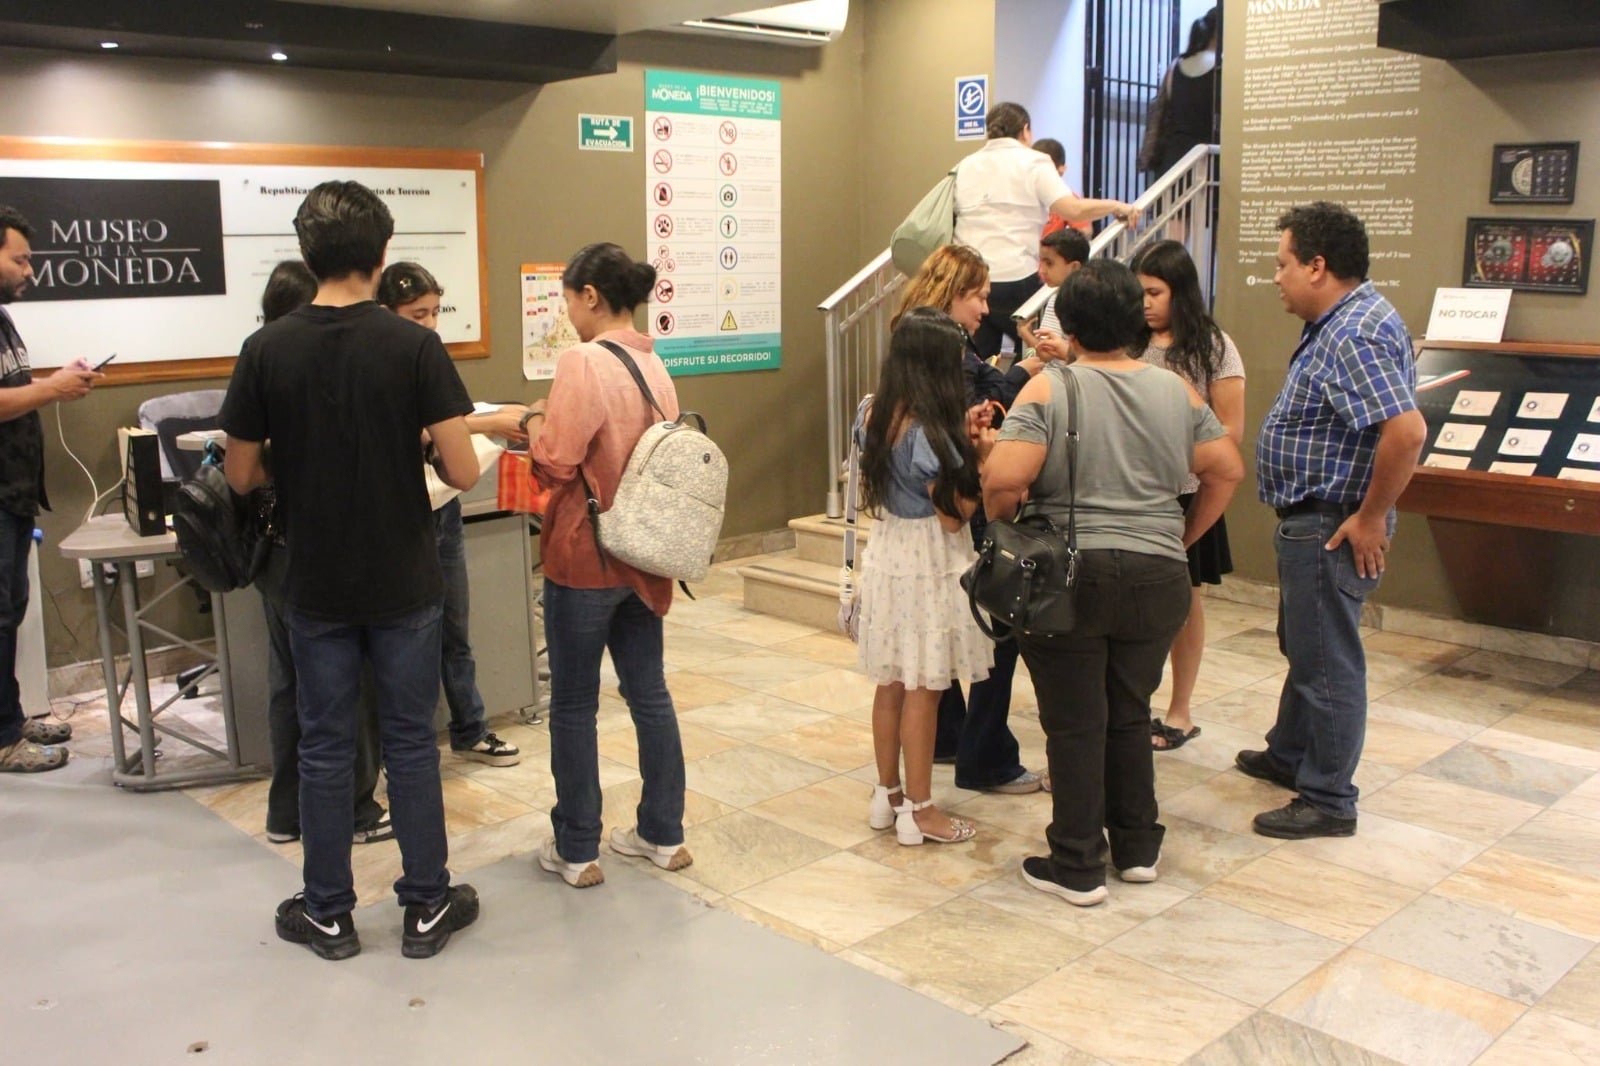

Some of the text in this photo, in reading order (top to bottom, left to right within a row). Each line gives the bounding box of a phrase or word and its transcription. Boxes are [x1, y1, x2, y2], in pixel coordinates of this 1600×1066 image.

[652, 88, 692, 102] MONEDA
[696, 85, 776, 102] ¡BIENVENIDOS!
[590, 118, 609, 126] RUTA
[398, 187, 430, 196] Torreón
[51, 219, 168, 244] MUSEO
[85, 244, 137, 257] DE LA
[31, 257, 200, 287] MONEDA
[1438, 310, 1498, 319] NO TOCAR
[708, 355, 718, 364] SU
[720, 352, 771, 363] RECORRIDO!
